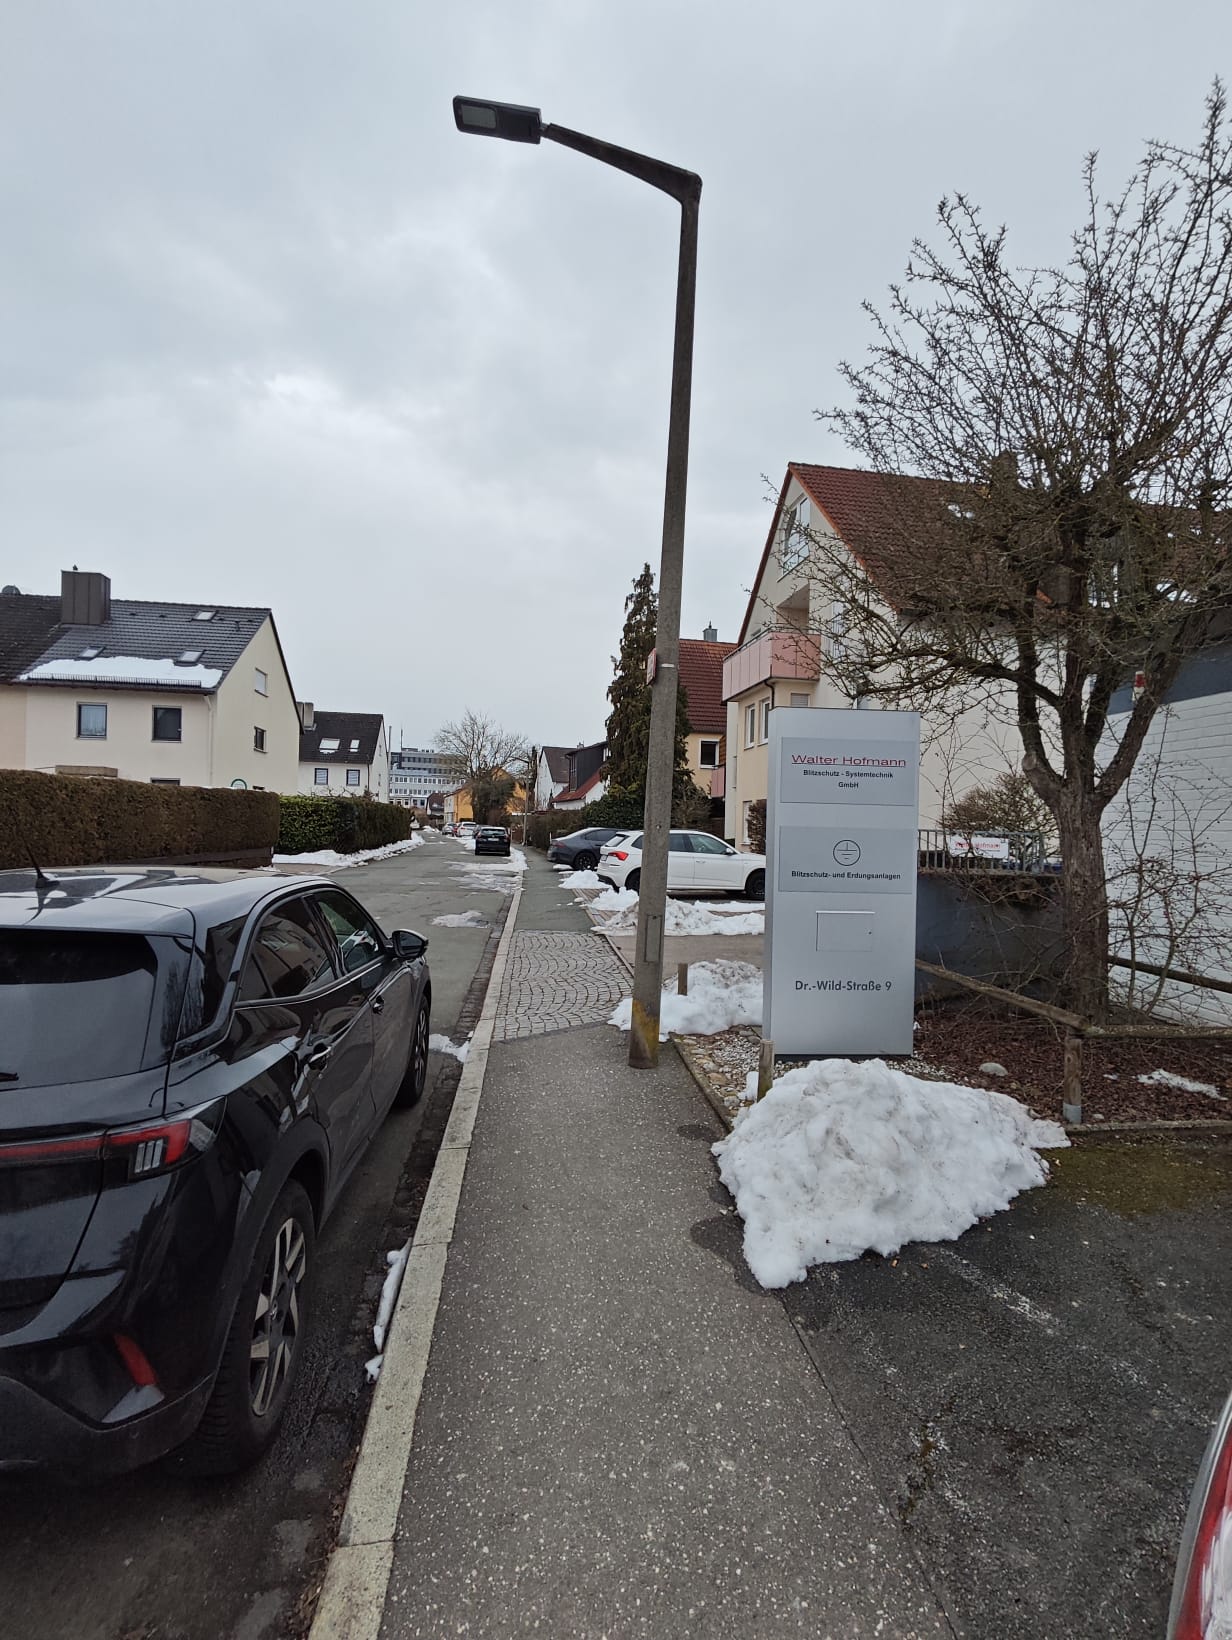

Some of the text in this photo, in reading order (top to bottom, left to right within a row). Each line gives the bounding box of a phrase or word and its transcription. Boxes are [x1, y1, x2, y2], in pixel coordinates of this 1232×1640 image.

[791, 754, 906, 767] Walter Hofmann
[803, 769, 840, 777] Blitzschutz
[845, 770, 893, 779] Systemtechnik
[791, 870, 831, 878] Blitzschutz-
[847, 871, 901, 880] Erdungsanlagen
[795, 980, 892, 991] Dr.-Wild-Straße 9
